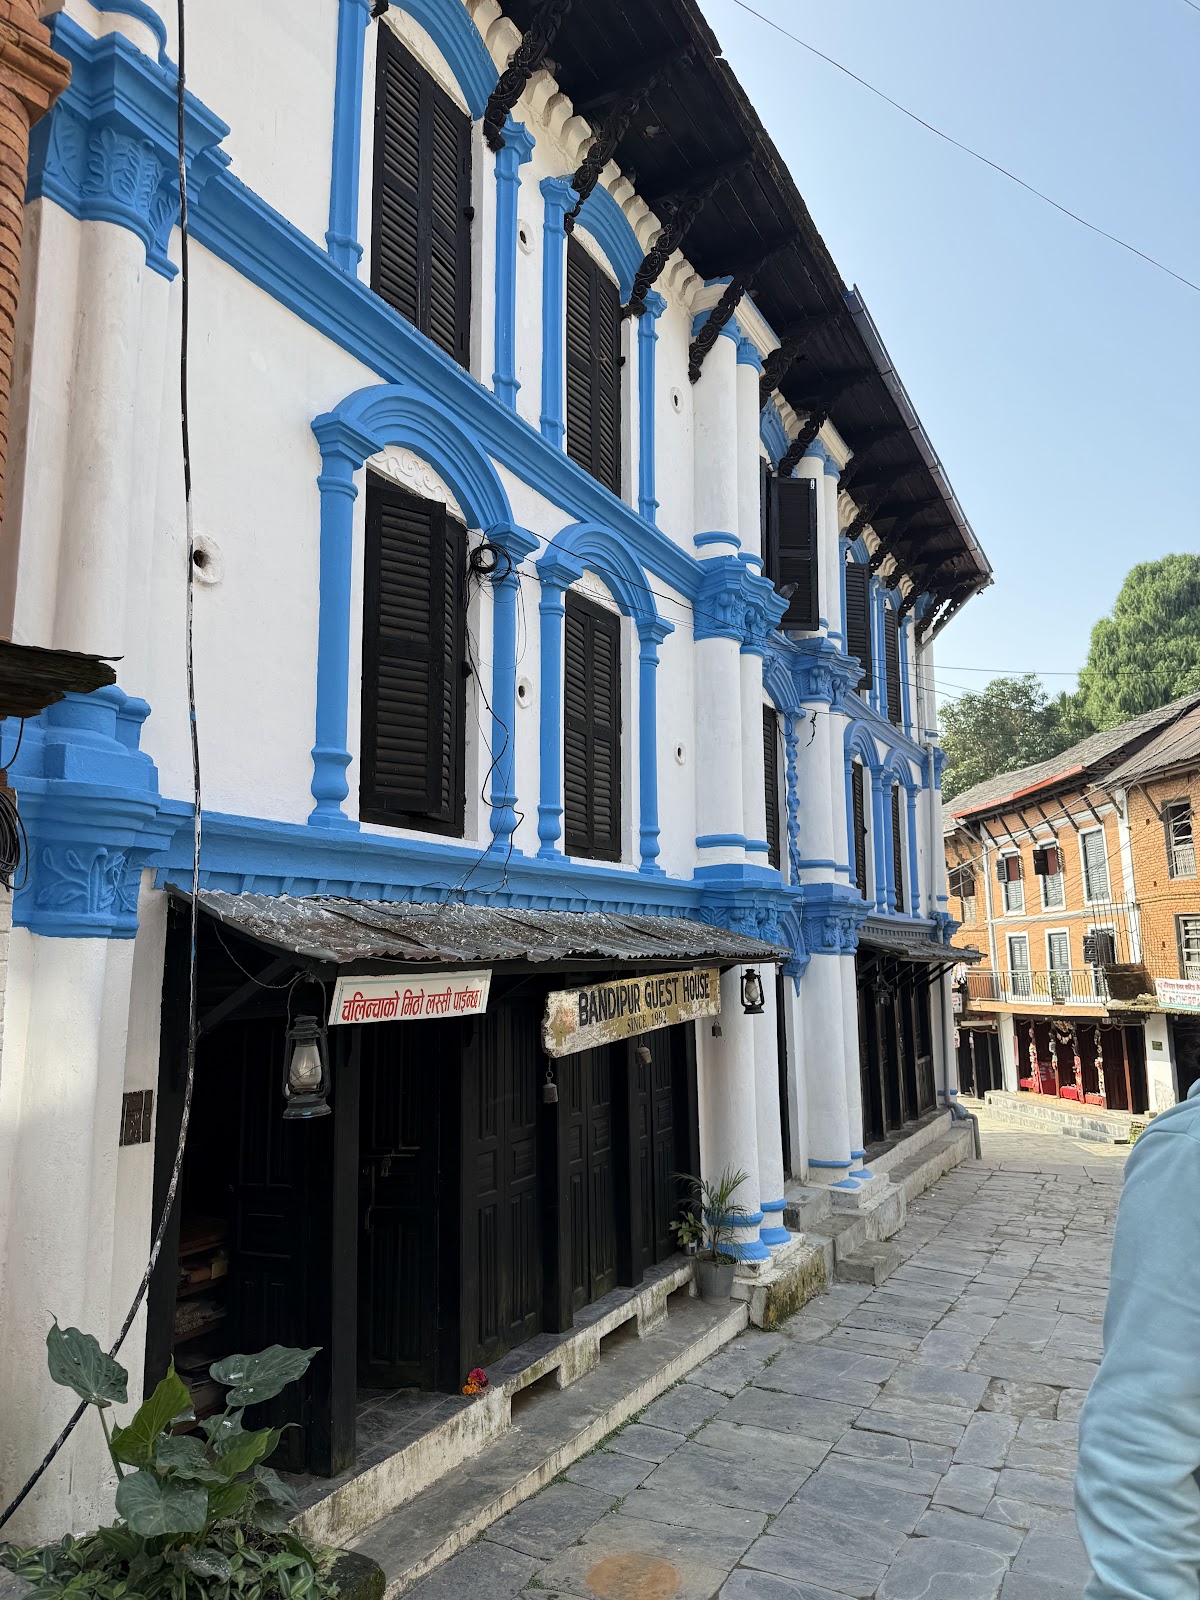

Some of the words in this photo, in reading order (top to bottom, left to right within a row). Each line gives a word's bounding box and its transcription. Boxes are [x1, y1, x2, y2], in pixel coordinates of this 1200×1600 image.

[400, 988, 425, 1016] मिठो
[425, 986, 452, 1014] लस्सी
[578, 983, 641, 1026] BANDIPUR
[644, 977, 679, 1009] GUEST
[682, 973, 710, 1003] HOUSE
